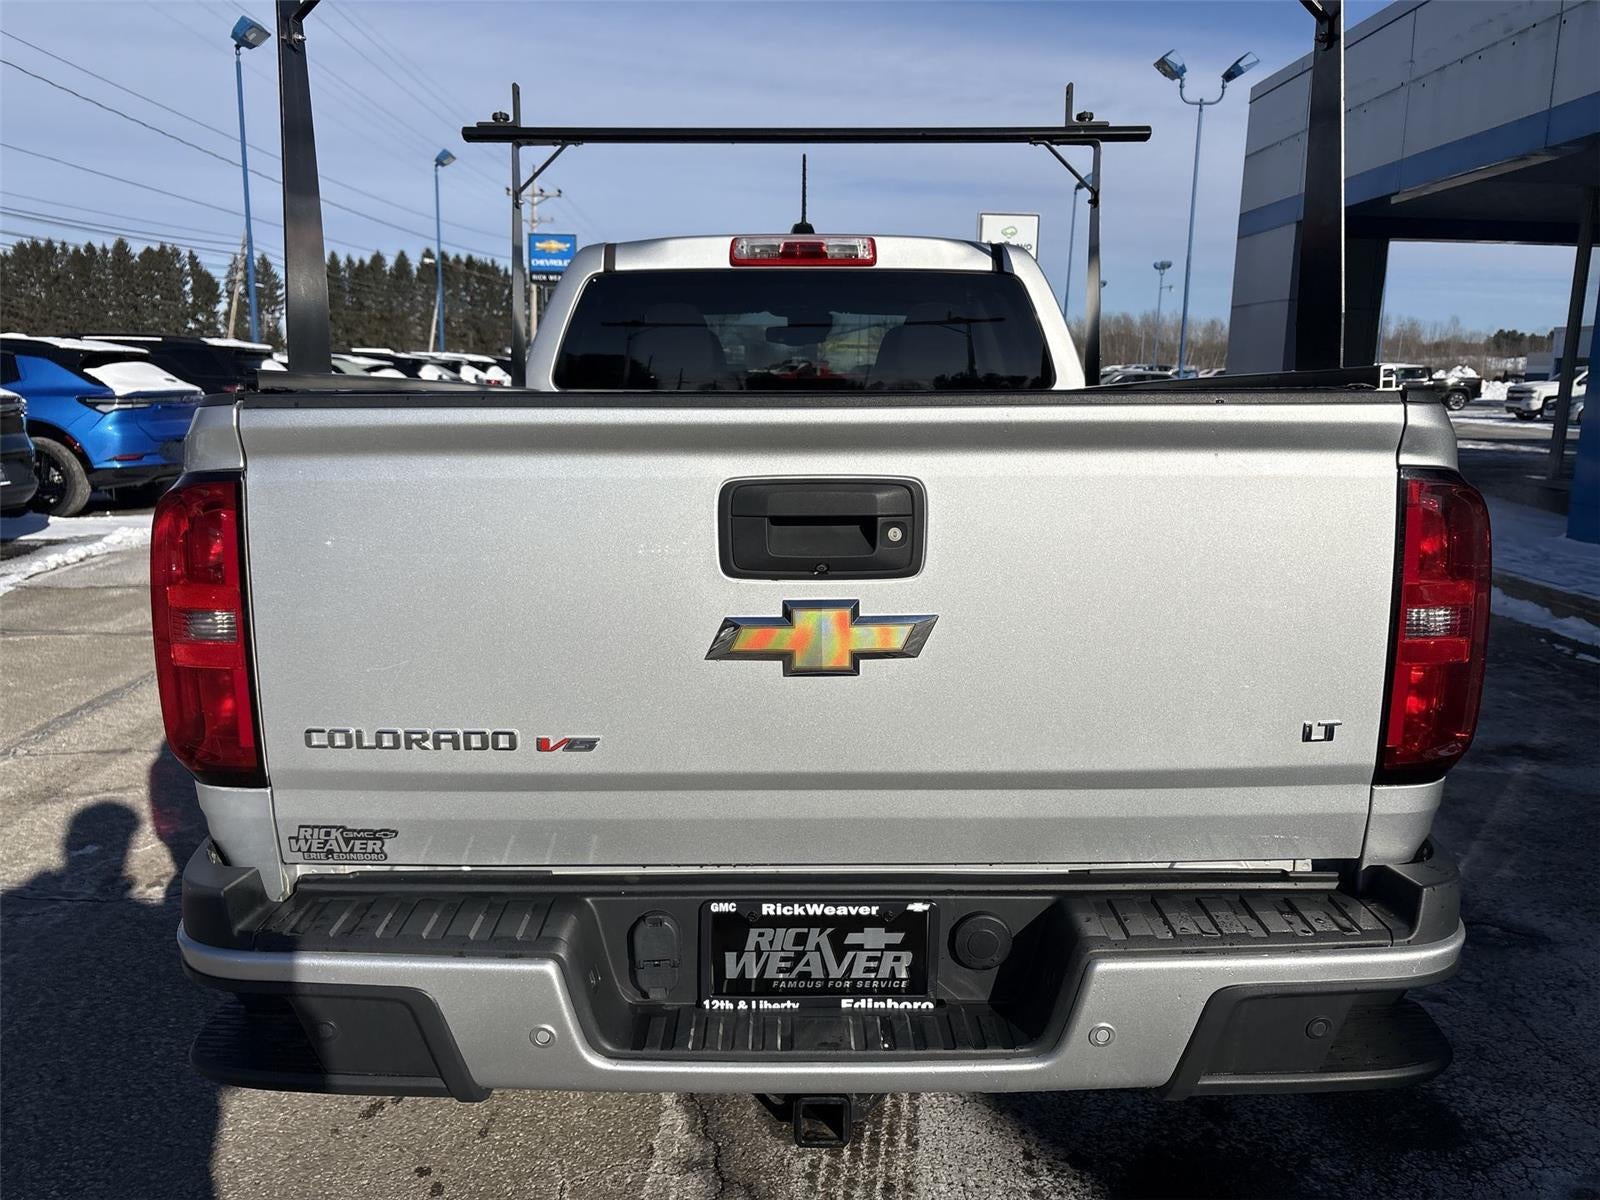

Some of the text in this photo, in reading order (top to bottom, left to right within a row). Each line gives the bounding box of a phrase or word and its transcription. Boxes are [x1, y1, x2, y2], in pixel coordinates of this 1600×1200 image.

[1302, 720, 1342, 742] LT
[304, 728, 518, 751] COLORADO
[536, 736, 600, 752] V6
[299, 827, 343, 840] RICK
[288, 838, 383, 853] WEAVER
[710, 902, 737, 913] GMC
[761, 903, 880, 916] RickWeaver
[744, 927, 836, 951] RICK
[724, 951, 914, 979] WEAVER
[772, 980, 908, 988] FAMOUS FOR SERVICE
[703, 999, 734, 1010] 12th
[737, 1000, 748, 1010] &
[841, 998, 935, 1009] Edinboro
